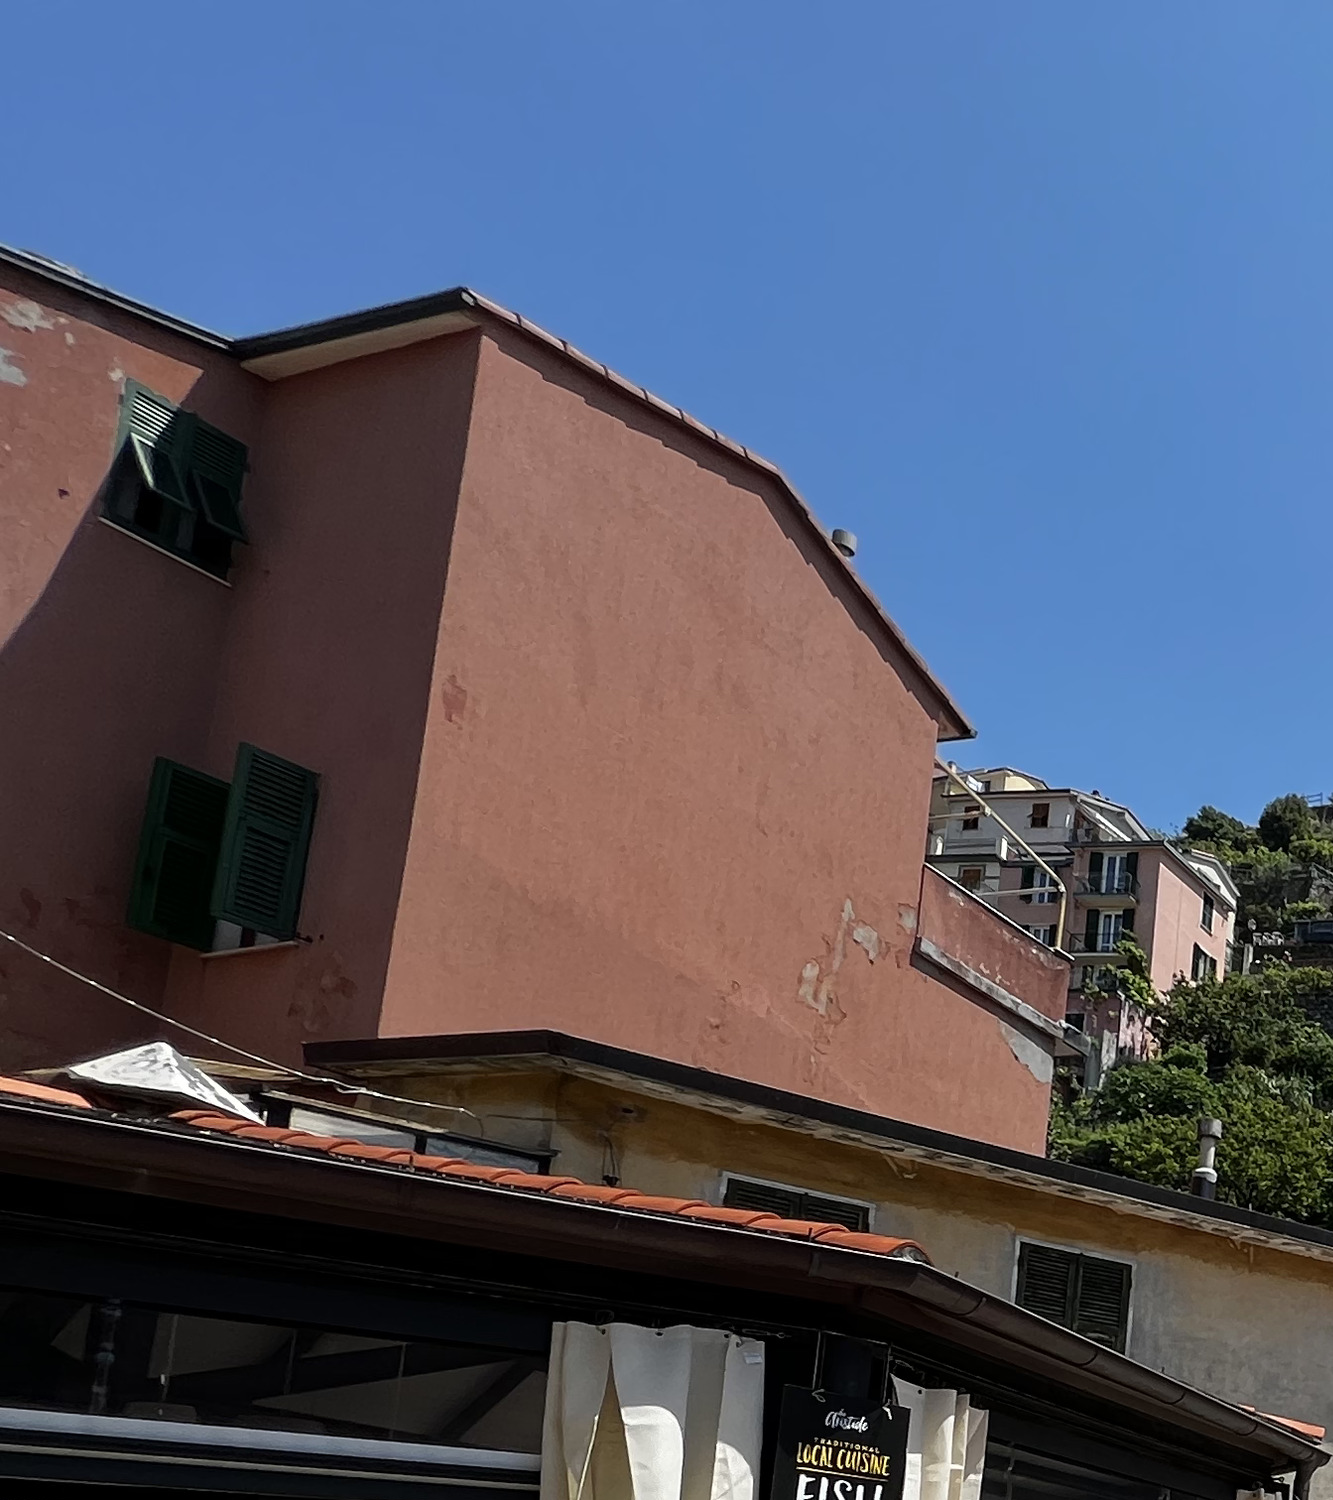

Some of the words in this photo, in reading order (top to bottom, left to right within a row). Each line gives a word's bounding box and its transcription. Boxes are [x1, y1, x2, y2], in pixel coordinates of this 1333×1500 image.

[814, 1437, 880, 1453] TRADITIONAL
[797, 1442, 833, 1468] LOCAL
[836, 1449, 890, 1476] CUISINE
